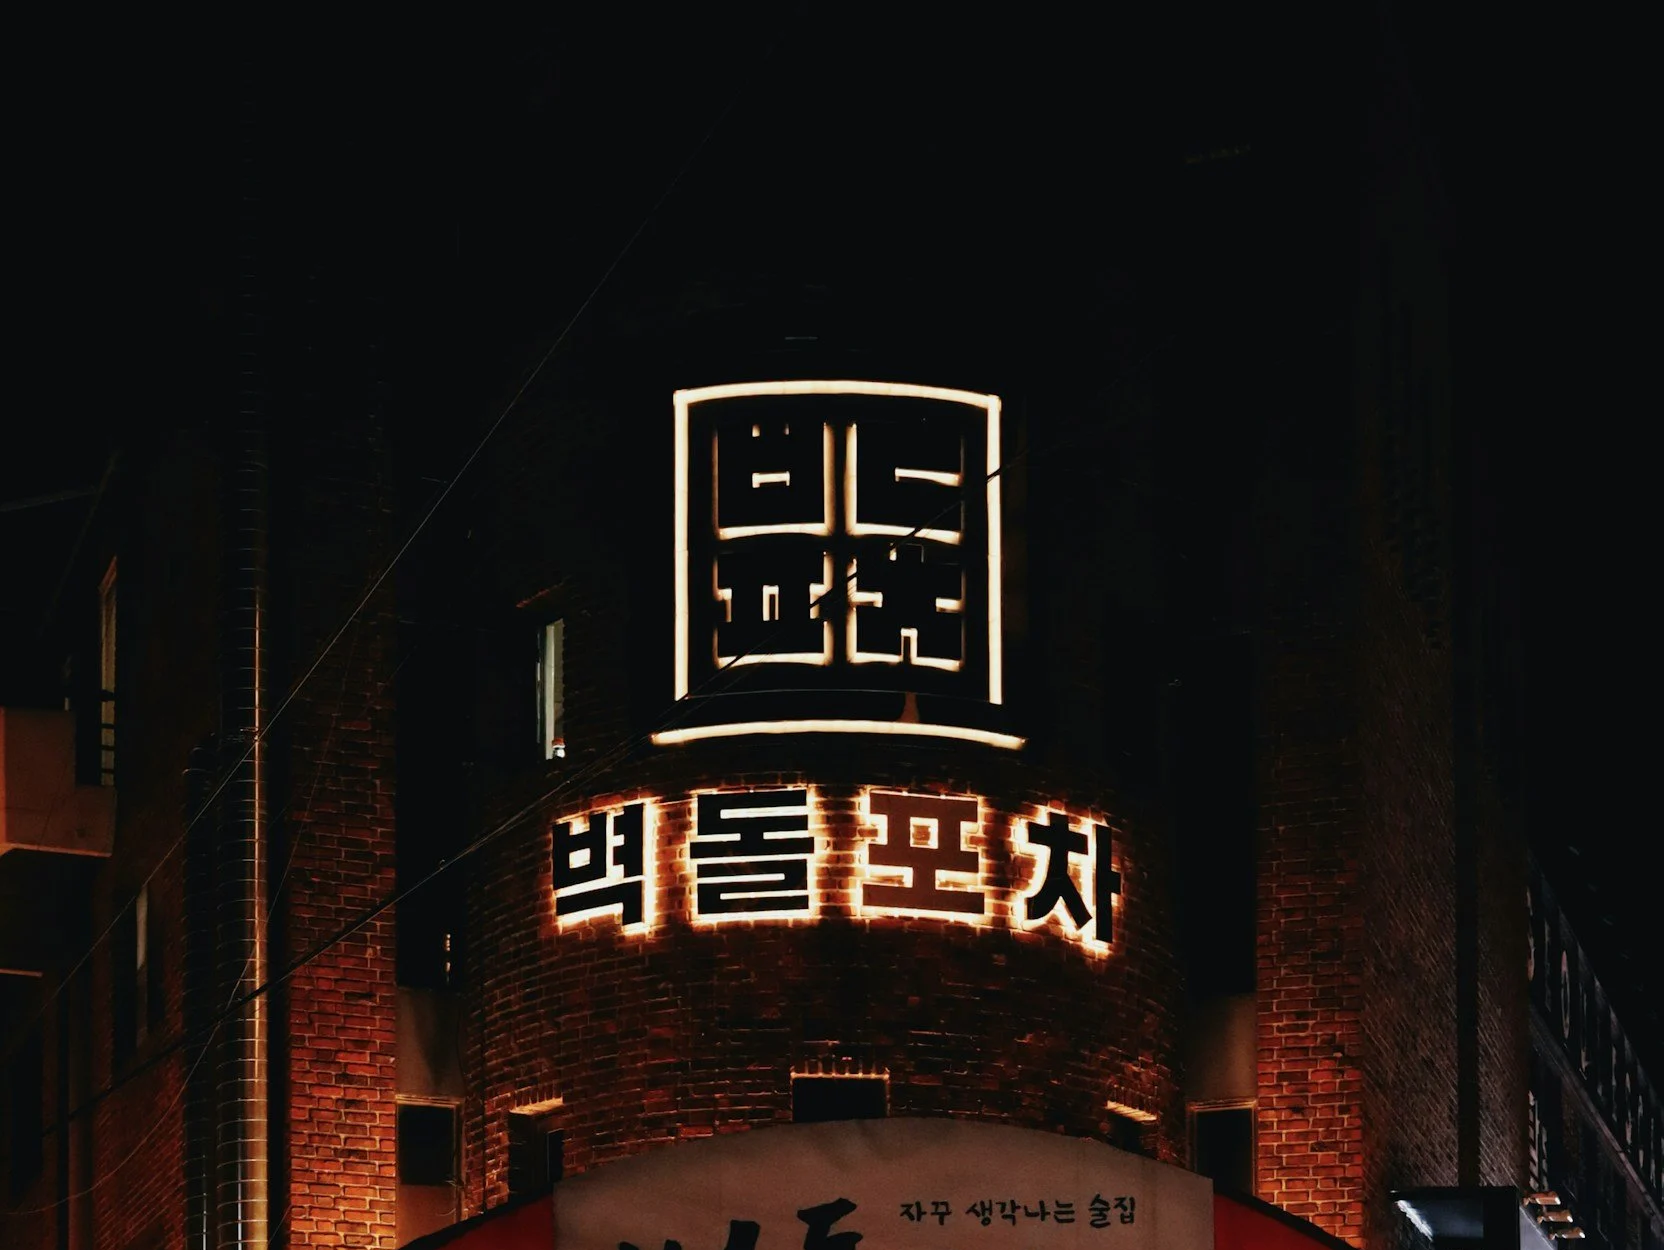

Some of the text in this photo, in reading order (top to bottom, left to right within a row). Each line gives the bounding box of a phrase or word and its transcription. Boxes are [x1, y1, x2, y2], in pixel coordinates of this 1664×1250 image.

[551, 783, 1122, 946] 벽돌포차
[900, 1193, 1136, 1229] 자꾸 생각나는 술집
